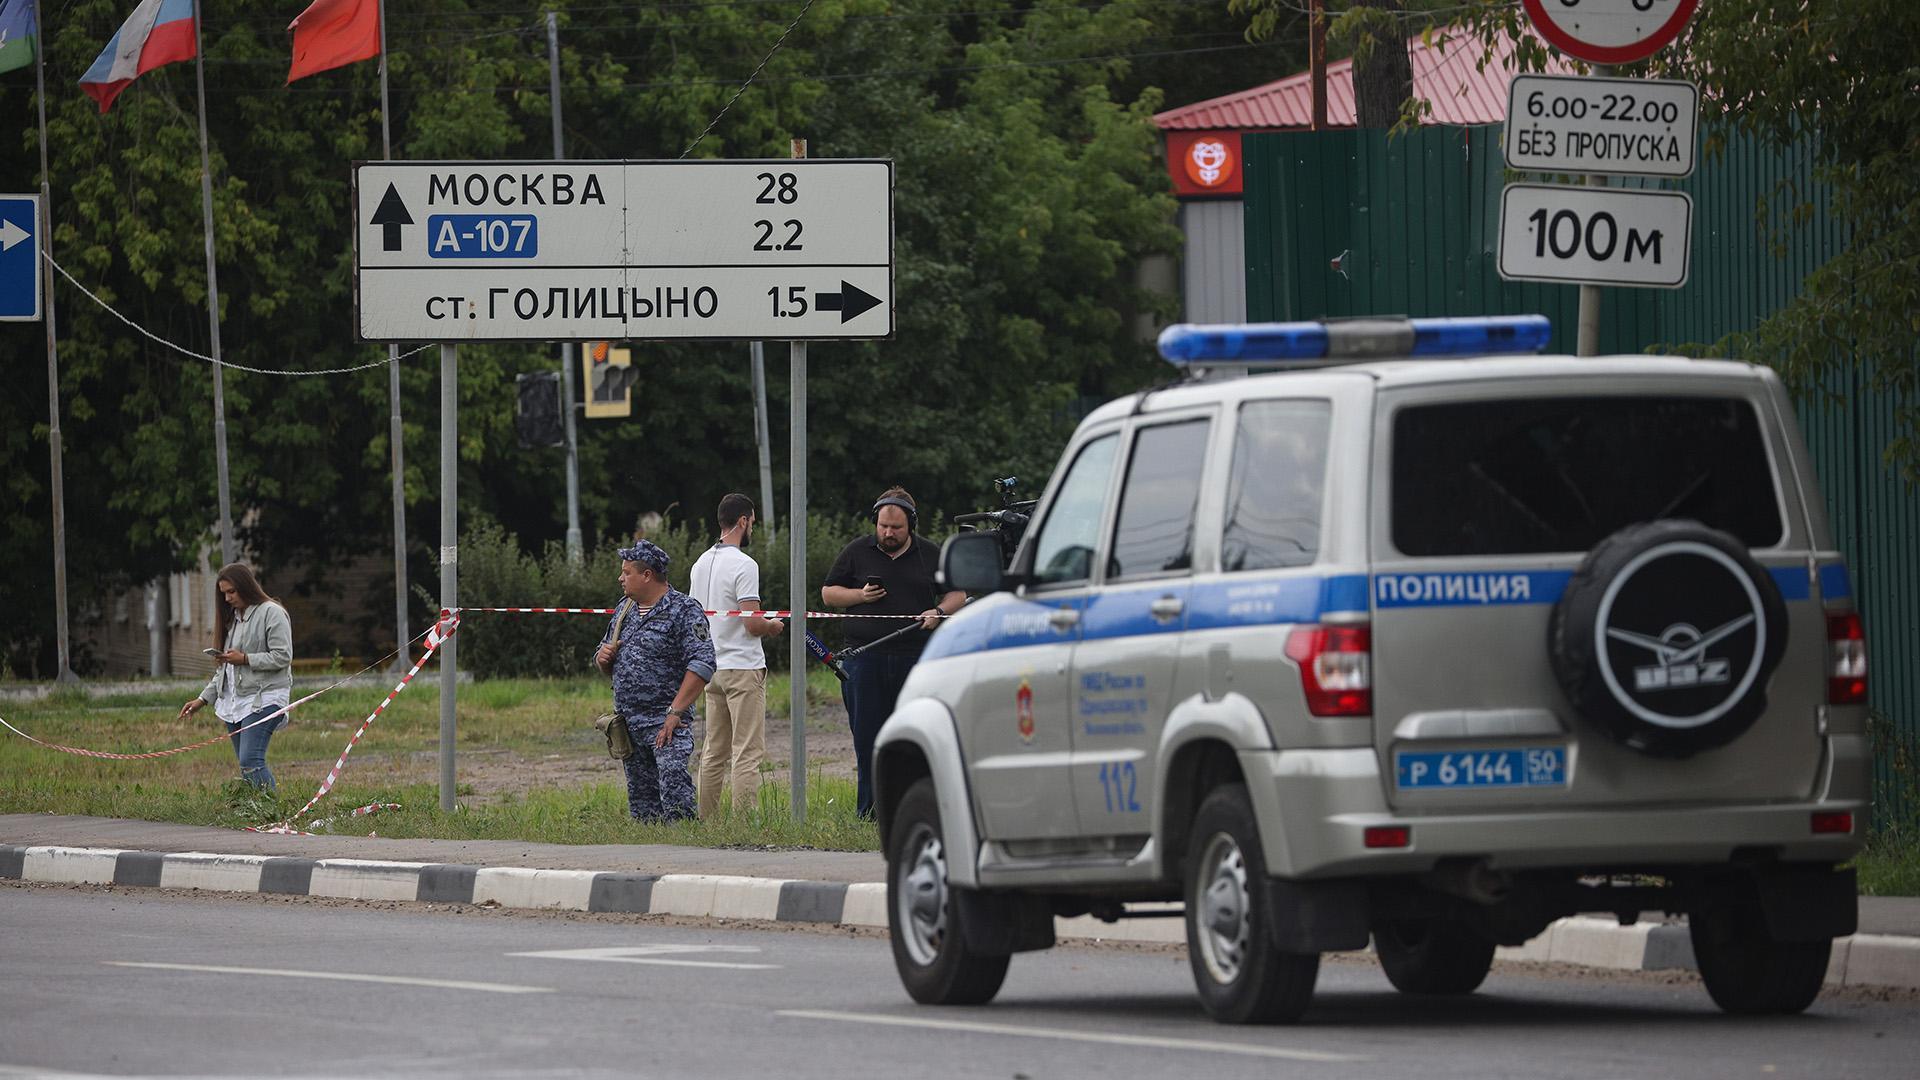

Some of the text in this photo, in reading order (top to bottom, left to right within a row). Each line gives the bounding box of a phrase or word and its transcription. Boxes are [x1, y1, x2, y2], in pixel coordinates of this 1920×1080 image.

[1527, 90, 1679, 124] 6.00-22.00
[1517, 128, 1681, 163] БЕЗ ПРОПУСКА
[427, 172, 799, 206] МОСКВА 28
[434, 218, 804, 252] А-107 2.2
[425, 286, 808, 325] ст. ГОЛИЦЫНО 1.5
[1378, 575, 1530, 603] ПОЛИЦИЯ
[1438, 753, 1512, 785] 6144
[1527, 750, 1557, 774] 50
[1098, 760, 1141, 812] 112
